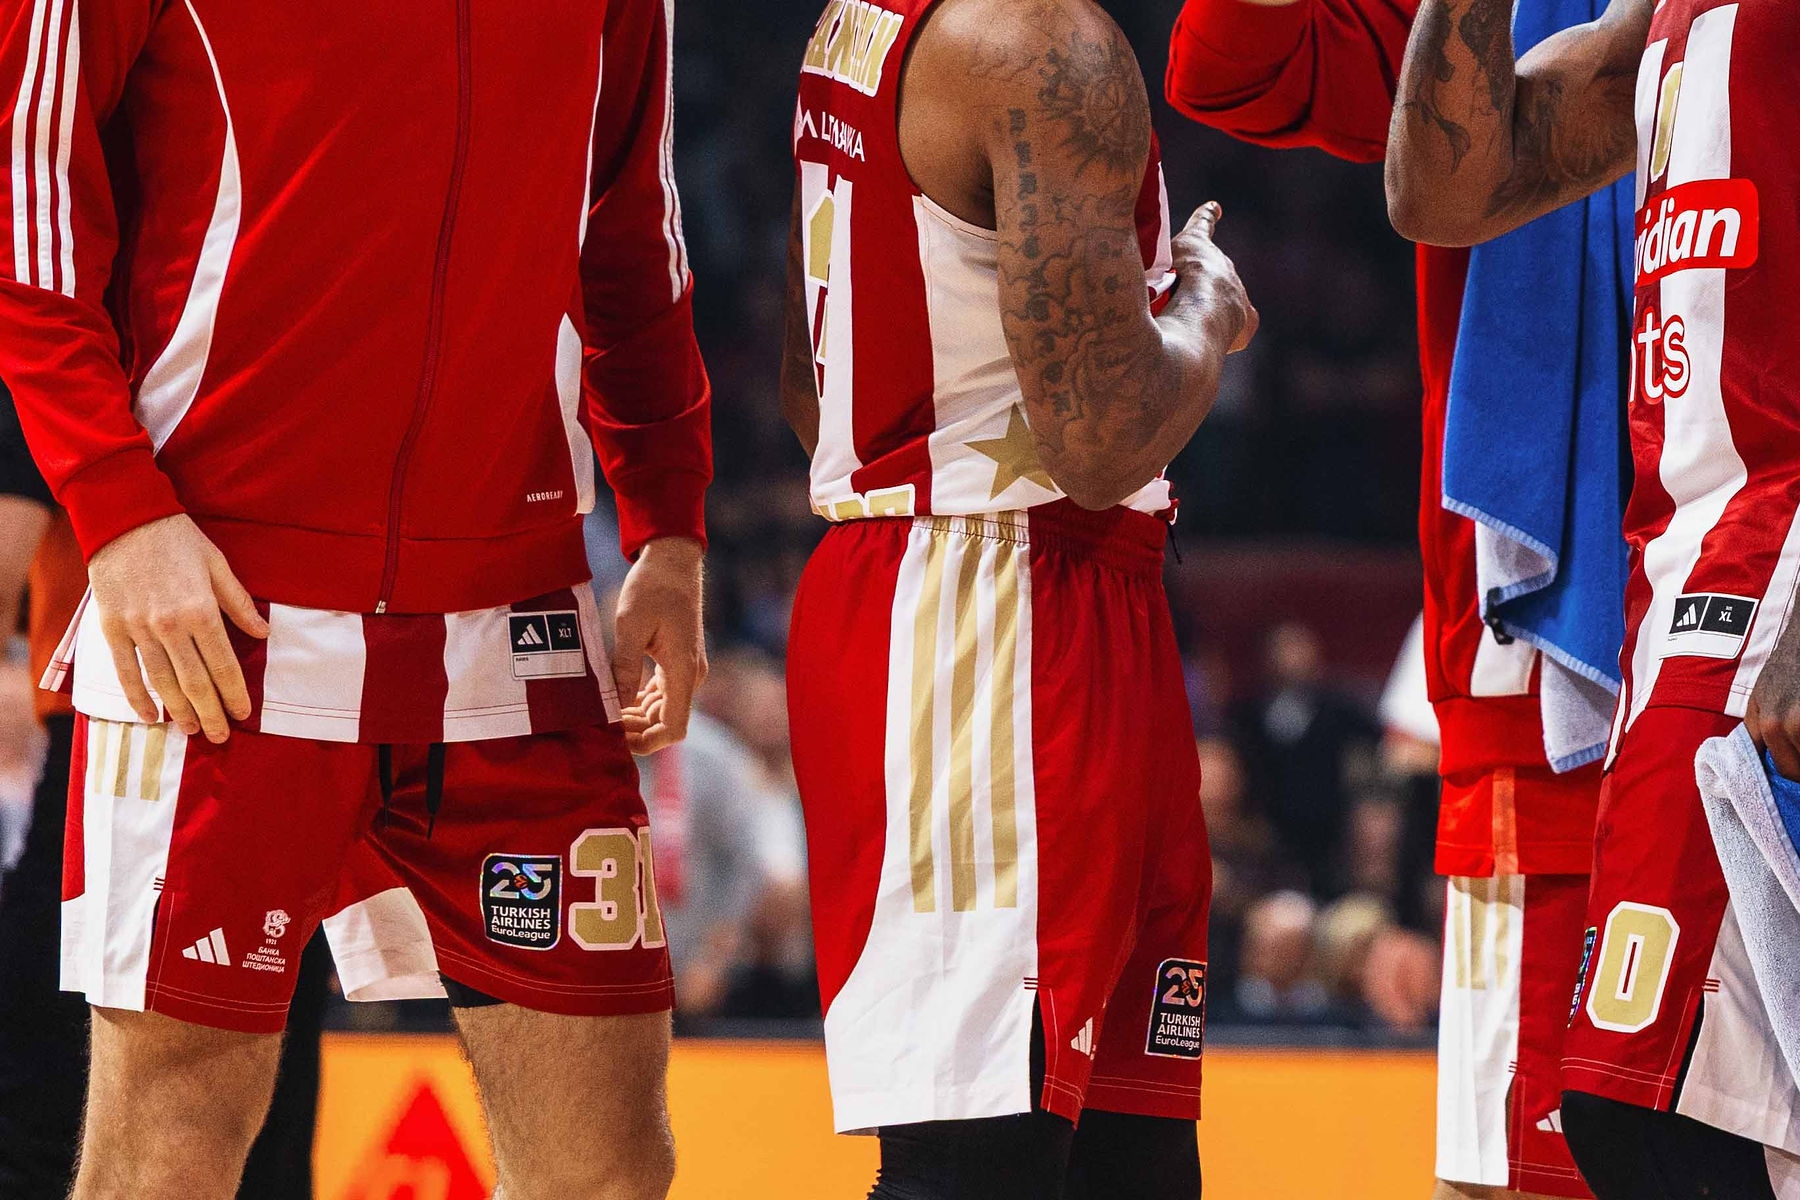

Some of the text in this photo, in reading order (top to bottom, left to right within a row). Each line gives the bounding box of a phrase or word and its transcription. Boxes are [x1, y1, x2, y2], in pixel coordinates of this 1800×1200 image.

[1718, 610, 1733, 623] XL
[558, 627, 573, 638] XLT
[489, 861, 553, 901] 25
[569, 826, 667, 951] 31
[490, 905, 551, 919] TURKISH
[491, 915, 551, 930] AIRLINES
[491, 924, 551, 942] EuroLeague
[246, 952, 286, 966] ПОШТАНСКА
[257, 946, 280, 956] БАНКА
[1585, 900, 1681, 1034] 0
[1161, 966, 1203, 1008] 25
[1160, 1012, 1201, 1028] TURKISH
[1157, 1023, 1200, 1039] AIRLINES
[1155, 1035, 1200, 1051] EuroLeague
